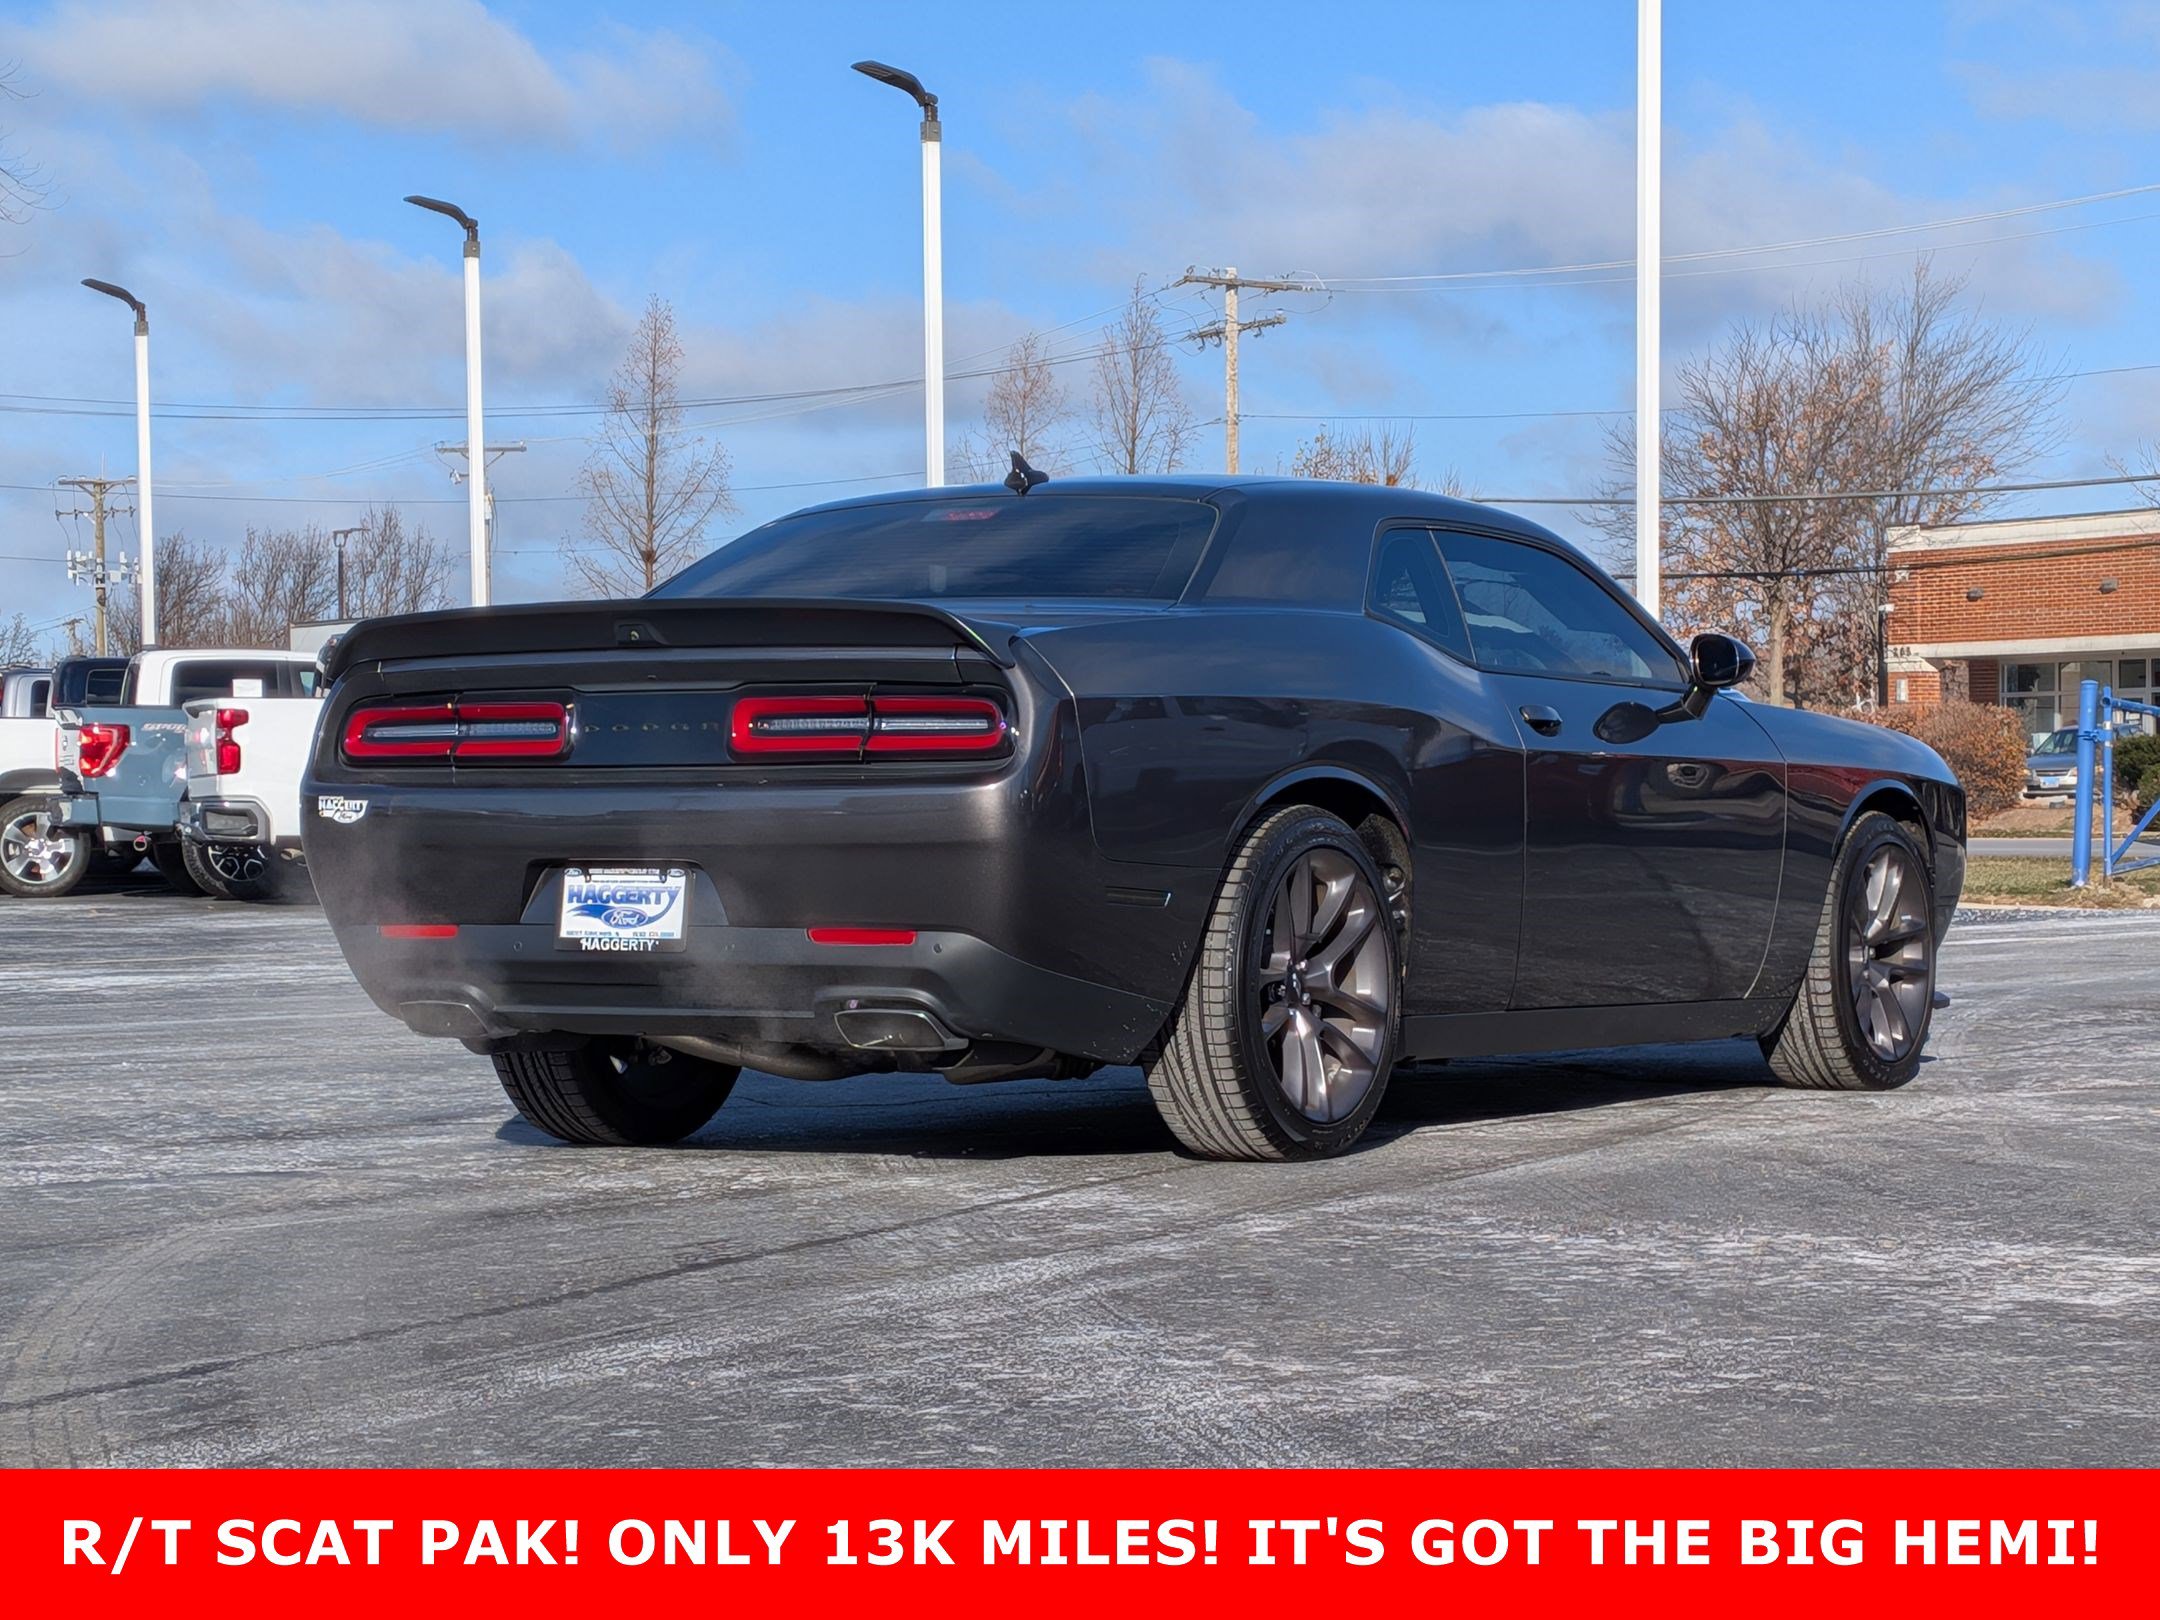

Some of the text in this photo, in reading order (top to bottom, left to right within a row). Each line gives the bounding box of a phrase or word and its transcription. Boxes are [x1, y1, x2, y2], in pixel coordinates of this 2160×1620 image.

[141, 722, 187, 733] SPOR
[567, 884, 682, 905] HAGGERTY
[608, 908, 642, 927] Ford
[581, 937, 657, 952] HAGGERTY
